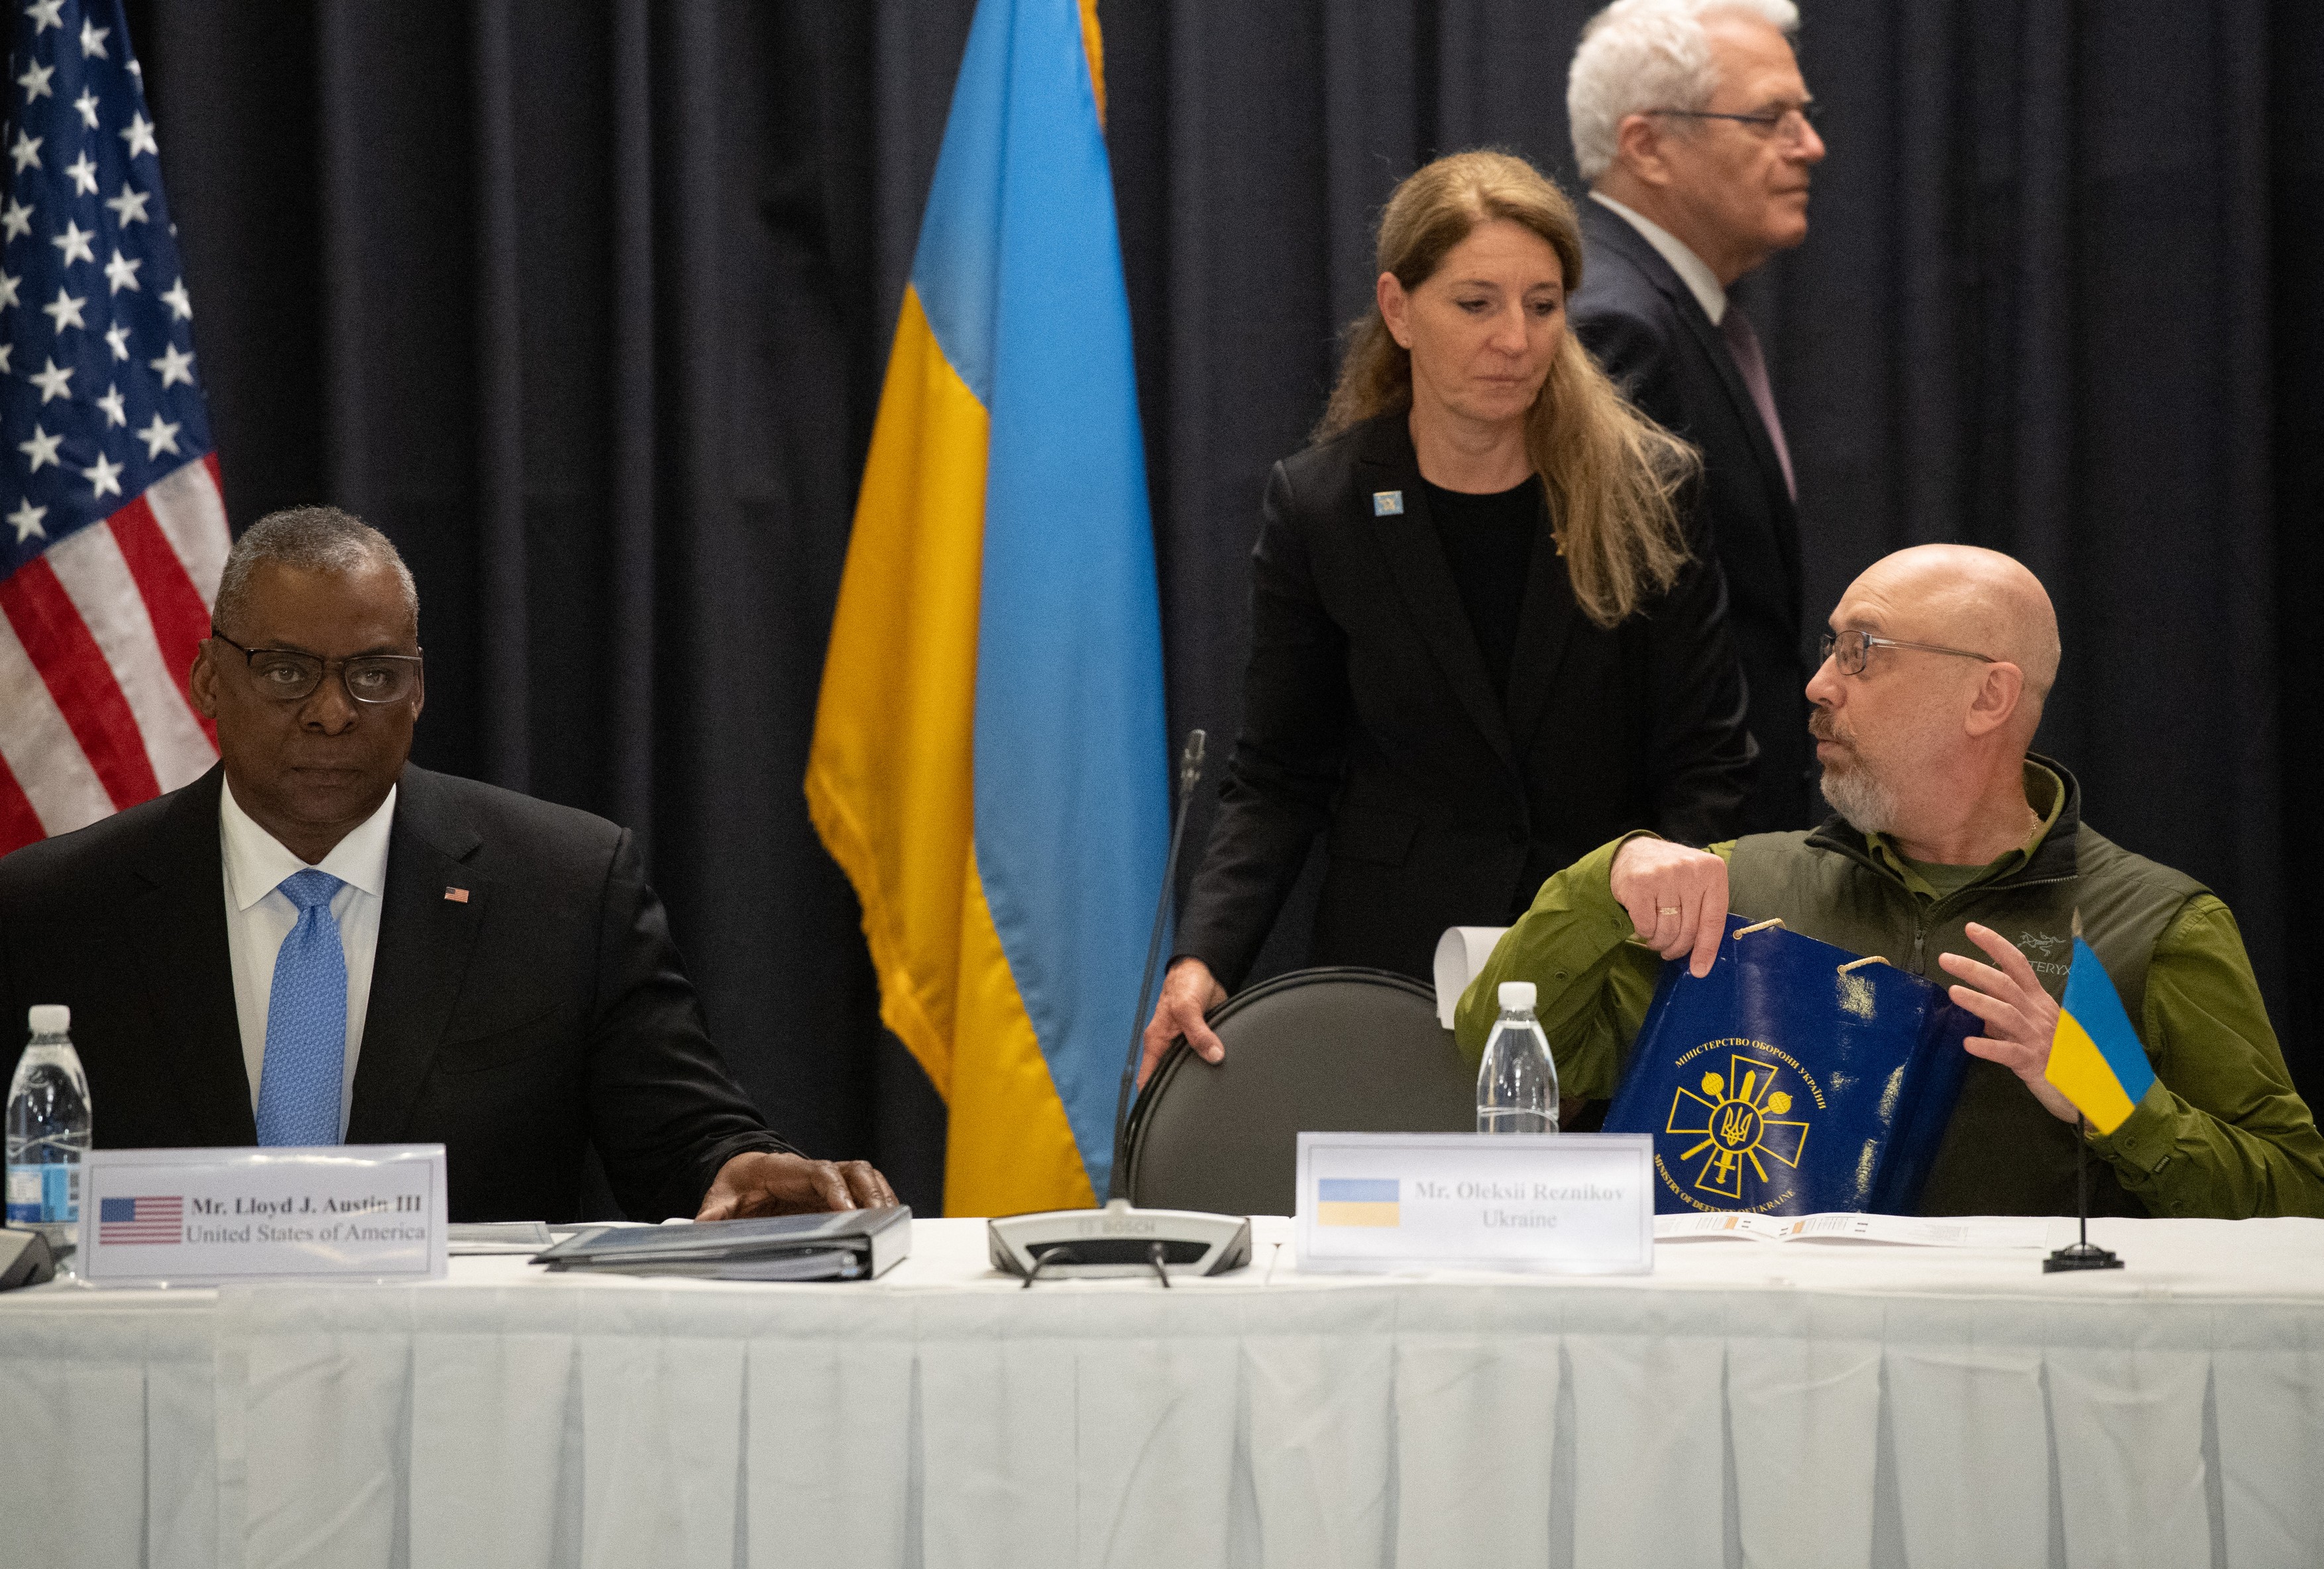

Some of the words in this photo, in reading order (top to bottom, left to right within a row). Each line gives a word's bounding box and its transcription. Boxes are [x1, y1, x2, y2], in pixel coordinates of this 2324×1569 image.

[1675, 1037, 1749, 1069] МІНІСТЕРСТВО
[1752, 1040, 1800, 1070] ОБОРОНИ
[1798, 1067, 1827, 1110] УКРАЇНИ
[1416, 1182, 1450, 1200] Mr.
[1457, 1181, 1525, 1200] Oleksii
[1533, 1183, 1625, 1202] Reznikov
[1654, 1153, 1681, 1194] MINISTRY
[1680, 1192, 1694, 1204] OF
[1751, 1189, 1796, 1214] UKRAINE
[192, 1198, 227, 1215] Mr.
[235, 1194, 292, 1218] Lloyd
[299, 1196, 317, 1214] J.
[323, 1195, 390, 1214] Austin
[396, 1195, 421, 1212] III
[1103, 1220, 1155, 1233] BOSCH
[1482, 1210, 1557, 1229] Ukraine
[186, 1224, 250, 1245] United
[256, 1224, 314, 1244] States
[319, 1222, 343, 1242] of
[343, 1223, 426, 1242] America
